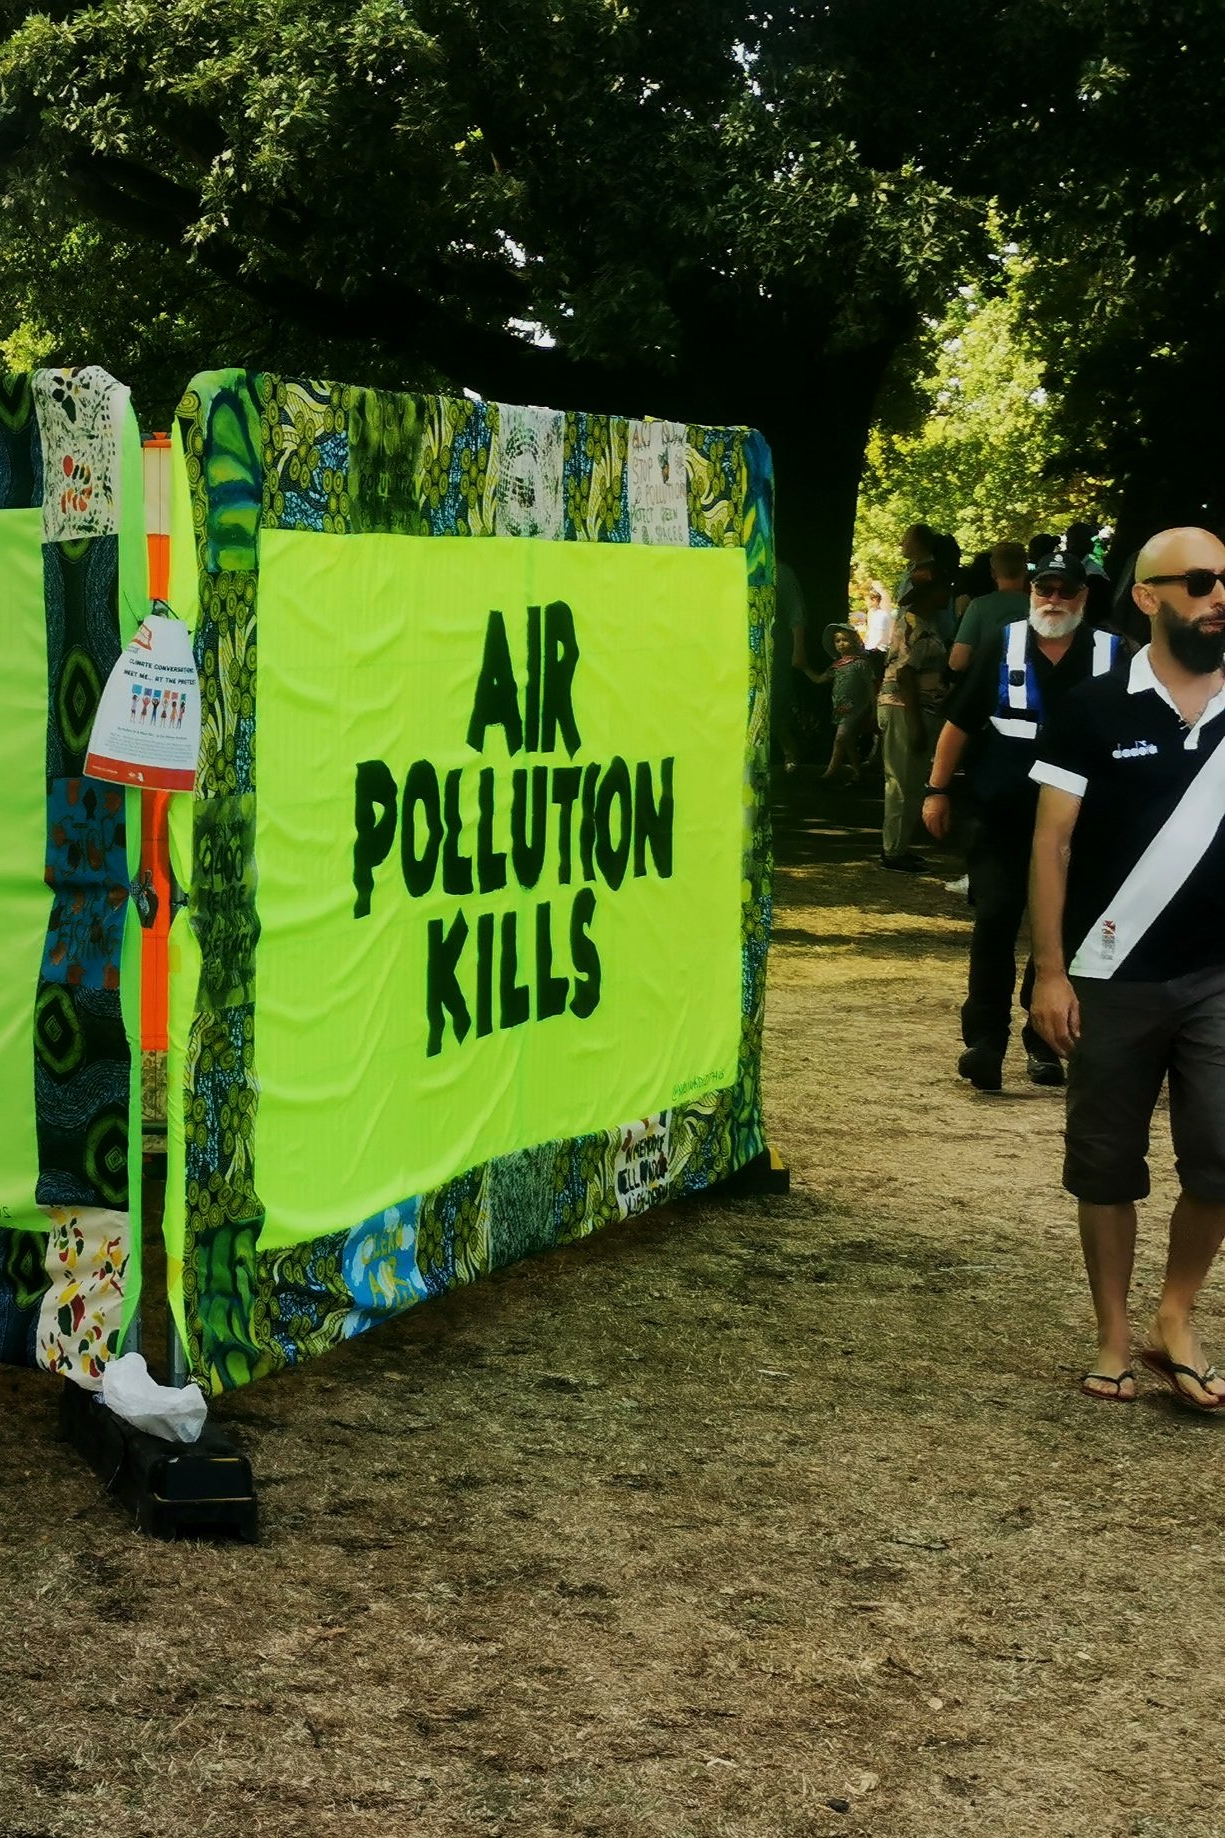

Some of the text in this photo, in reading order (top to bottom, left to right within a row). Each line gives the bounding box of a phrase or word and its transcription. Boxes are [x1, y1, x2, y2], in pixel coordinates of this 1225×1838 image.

[466, 600, 582, 761] AIR
[354, 756, 675, 919] POLLUTION
[426, 887, 601, 1057] KILLS
